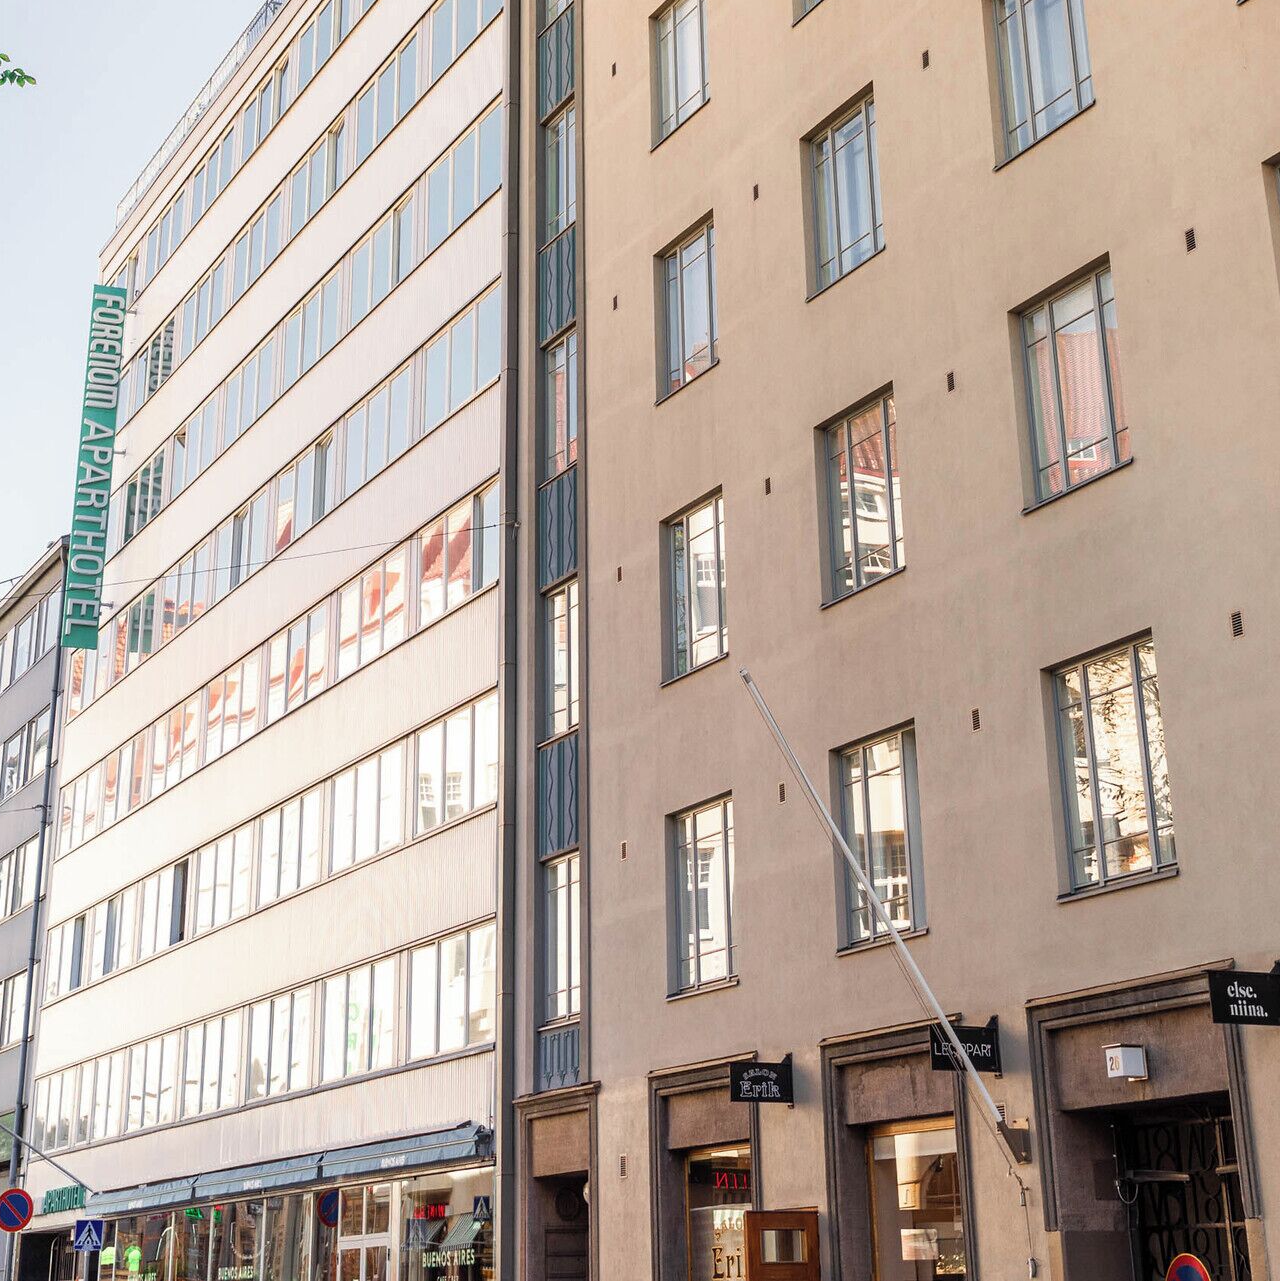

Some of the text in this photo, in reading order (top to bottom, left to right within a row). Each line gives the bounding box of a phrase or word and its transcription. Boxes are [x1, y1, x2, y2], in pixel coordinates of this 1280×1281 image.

[65, 292, 126, 636] FORENOM APARTHOTEL
[1226, 981, 1257, 999] else.
[1229, 999, 1269, 1018] niina.
[1109, 1055, 1120, 1072] 26
[742, 1068, 778, 1081] SALON
[739, 1081, 781, 1098] Erik
[42, 1185, 83, 1214] APARTHOTEL
[713, 1216, 743, 1242] SALO
[422, 1248, 475, 1268] BUENOS AIRES
[711, 1247, 743, 1280] Eri
[217, 1265, 253, 1280] BUENOS AIRES
